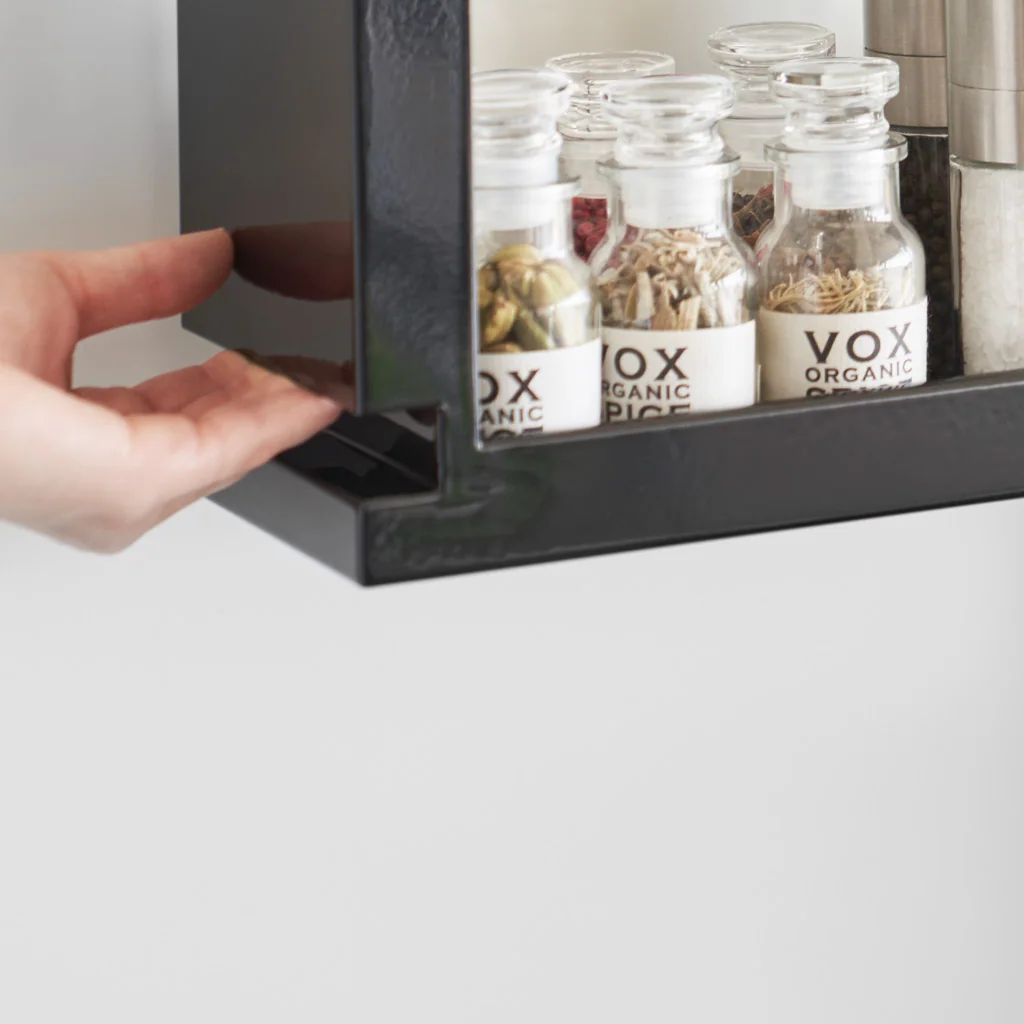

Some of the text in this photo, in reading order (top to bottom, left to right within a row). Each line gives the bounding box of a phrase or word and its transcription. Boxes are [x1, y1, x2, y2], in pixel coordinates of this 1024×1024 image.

[804, 322, 912, 364] VOX
[805, 358, 913, 383] ORGANIC
[478, 368, 541, 405] OX
[602, 380, 691, 401] RGANIC
[480, 406, 544, 425] ANIC
